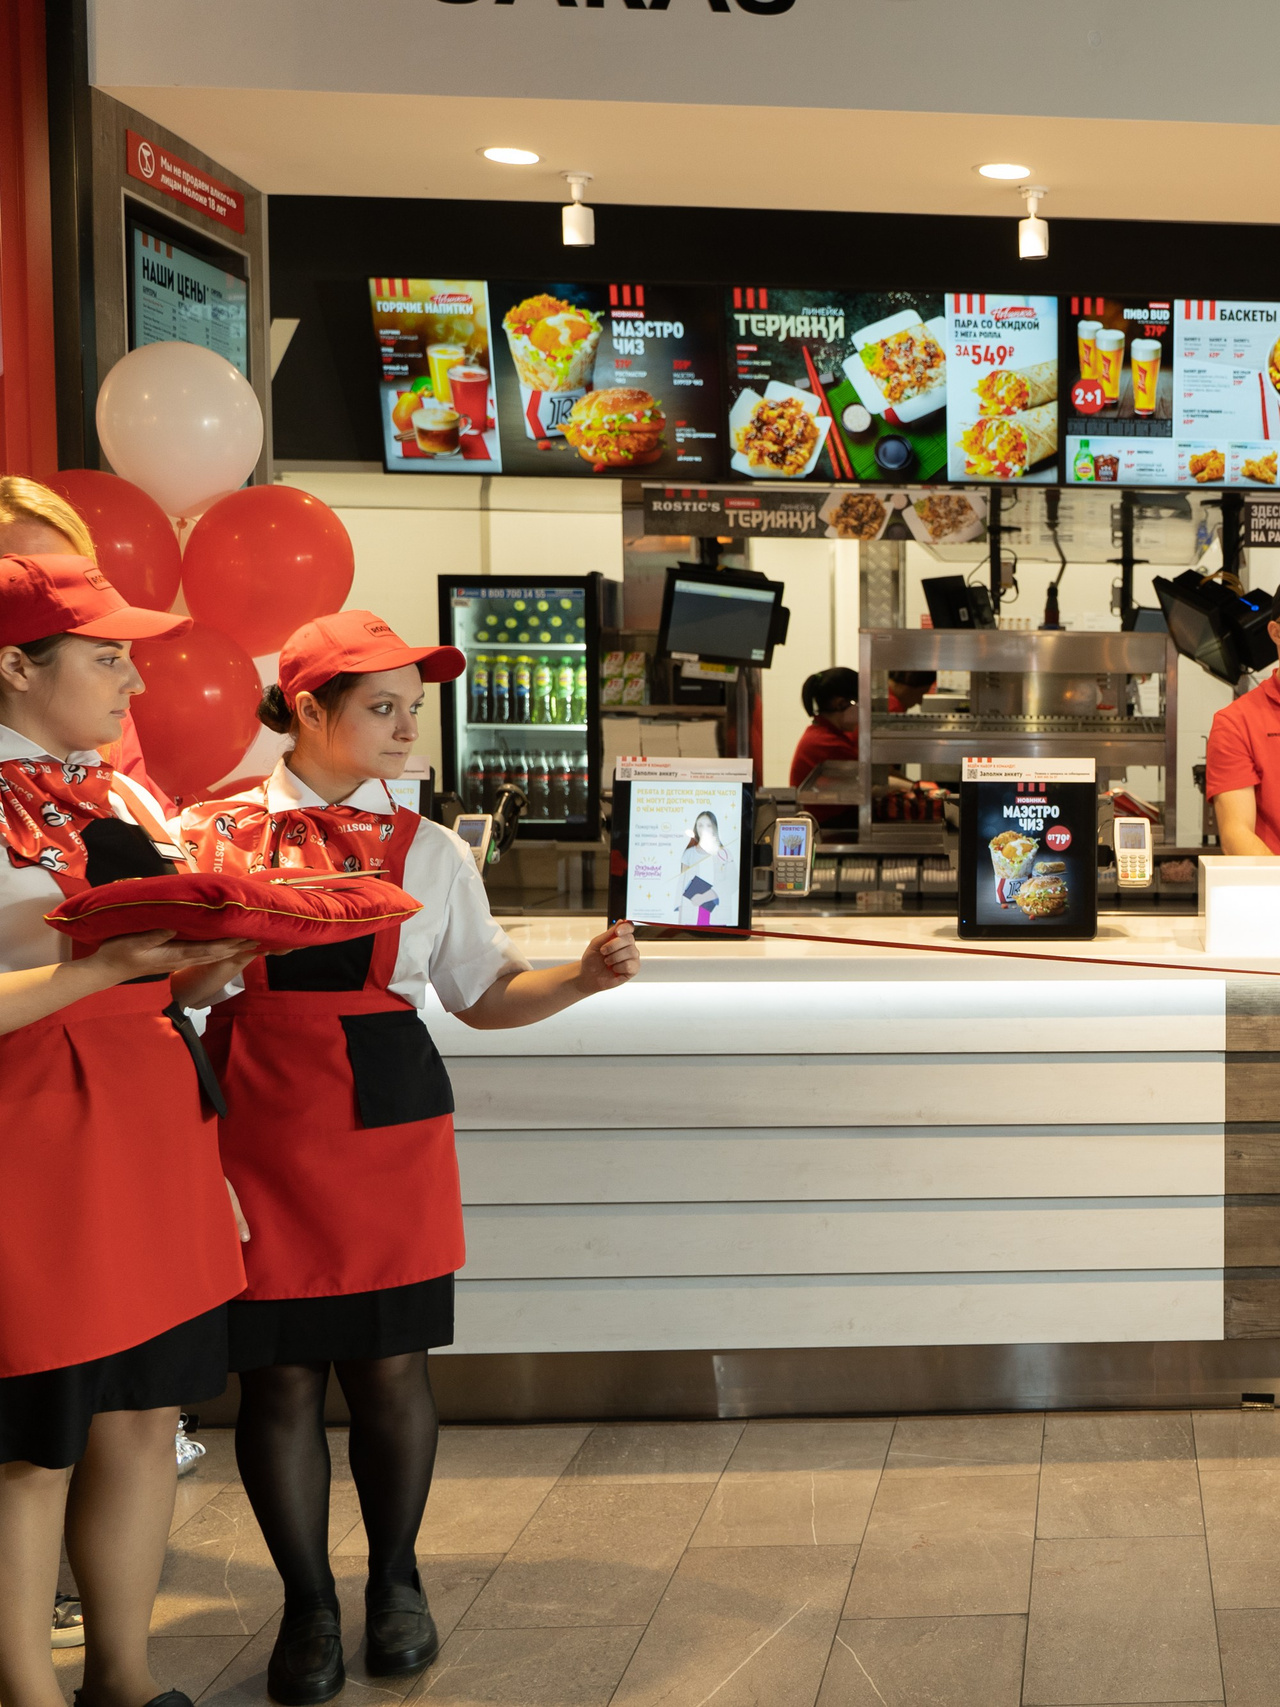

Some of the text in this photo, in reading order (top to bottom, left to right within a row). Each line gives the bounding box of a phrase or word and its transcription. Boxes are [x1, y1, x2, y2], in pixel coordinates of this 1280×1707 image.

[160, 155, 237, 209] Мы не продаем алкоголь
[160, 174, 227, 217] лицам моложе 18 лет
[142, 256, 175, 292] НАШИ
[376, 301, 474, 315] ГОРЯЧИЕ НАПИТКИ
[801, 306, 845, 317] ЛИНЕЙКА
[1123, 308, 1170, 320] ПИВО BUD
[1219, 308, 1277, 322] БАСКЕТЫ
[611, 320, 684, 339] МАЭСТРО
[733, 313, 845, 343] ТЕРИЯКИ
[954, 318, 1040, 331] ПАРА СО СКИДКОЙ
[613, 339, 645, 355] ЧИЗ
[955, 345, 970, 356] ЗА
[1075, 388, 1101, 405] 2+1
[652, 500, 720, 513] ROSTIC'S
[724, 508, 817, 533] ТЕРИЯКИ
[1250, 531, 1266, 543] НА
[1003, 805, 1060, 818] МАЭСТРО
[1018, 818, 1044, 831] ЧИЗ
